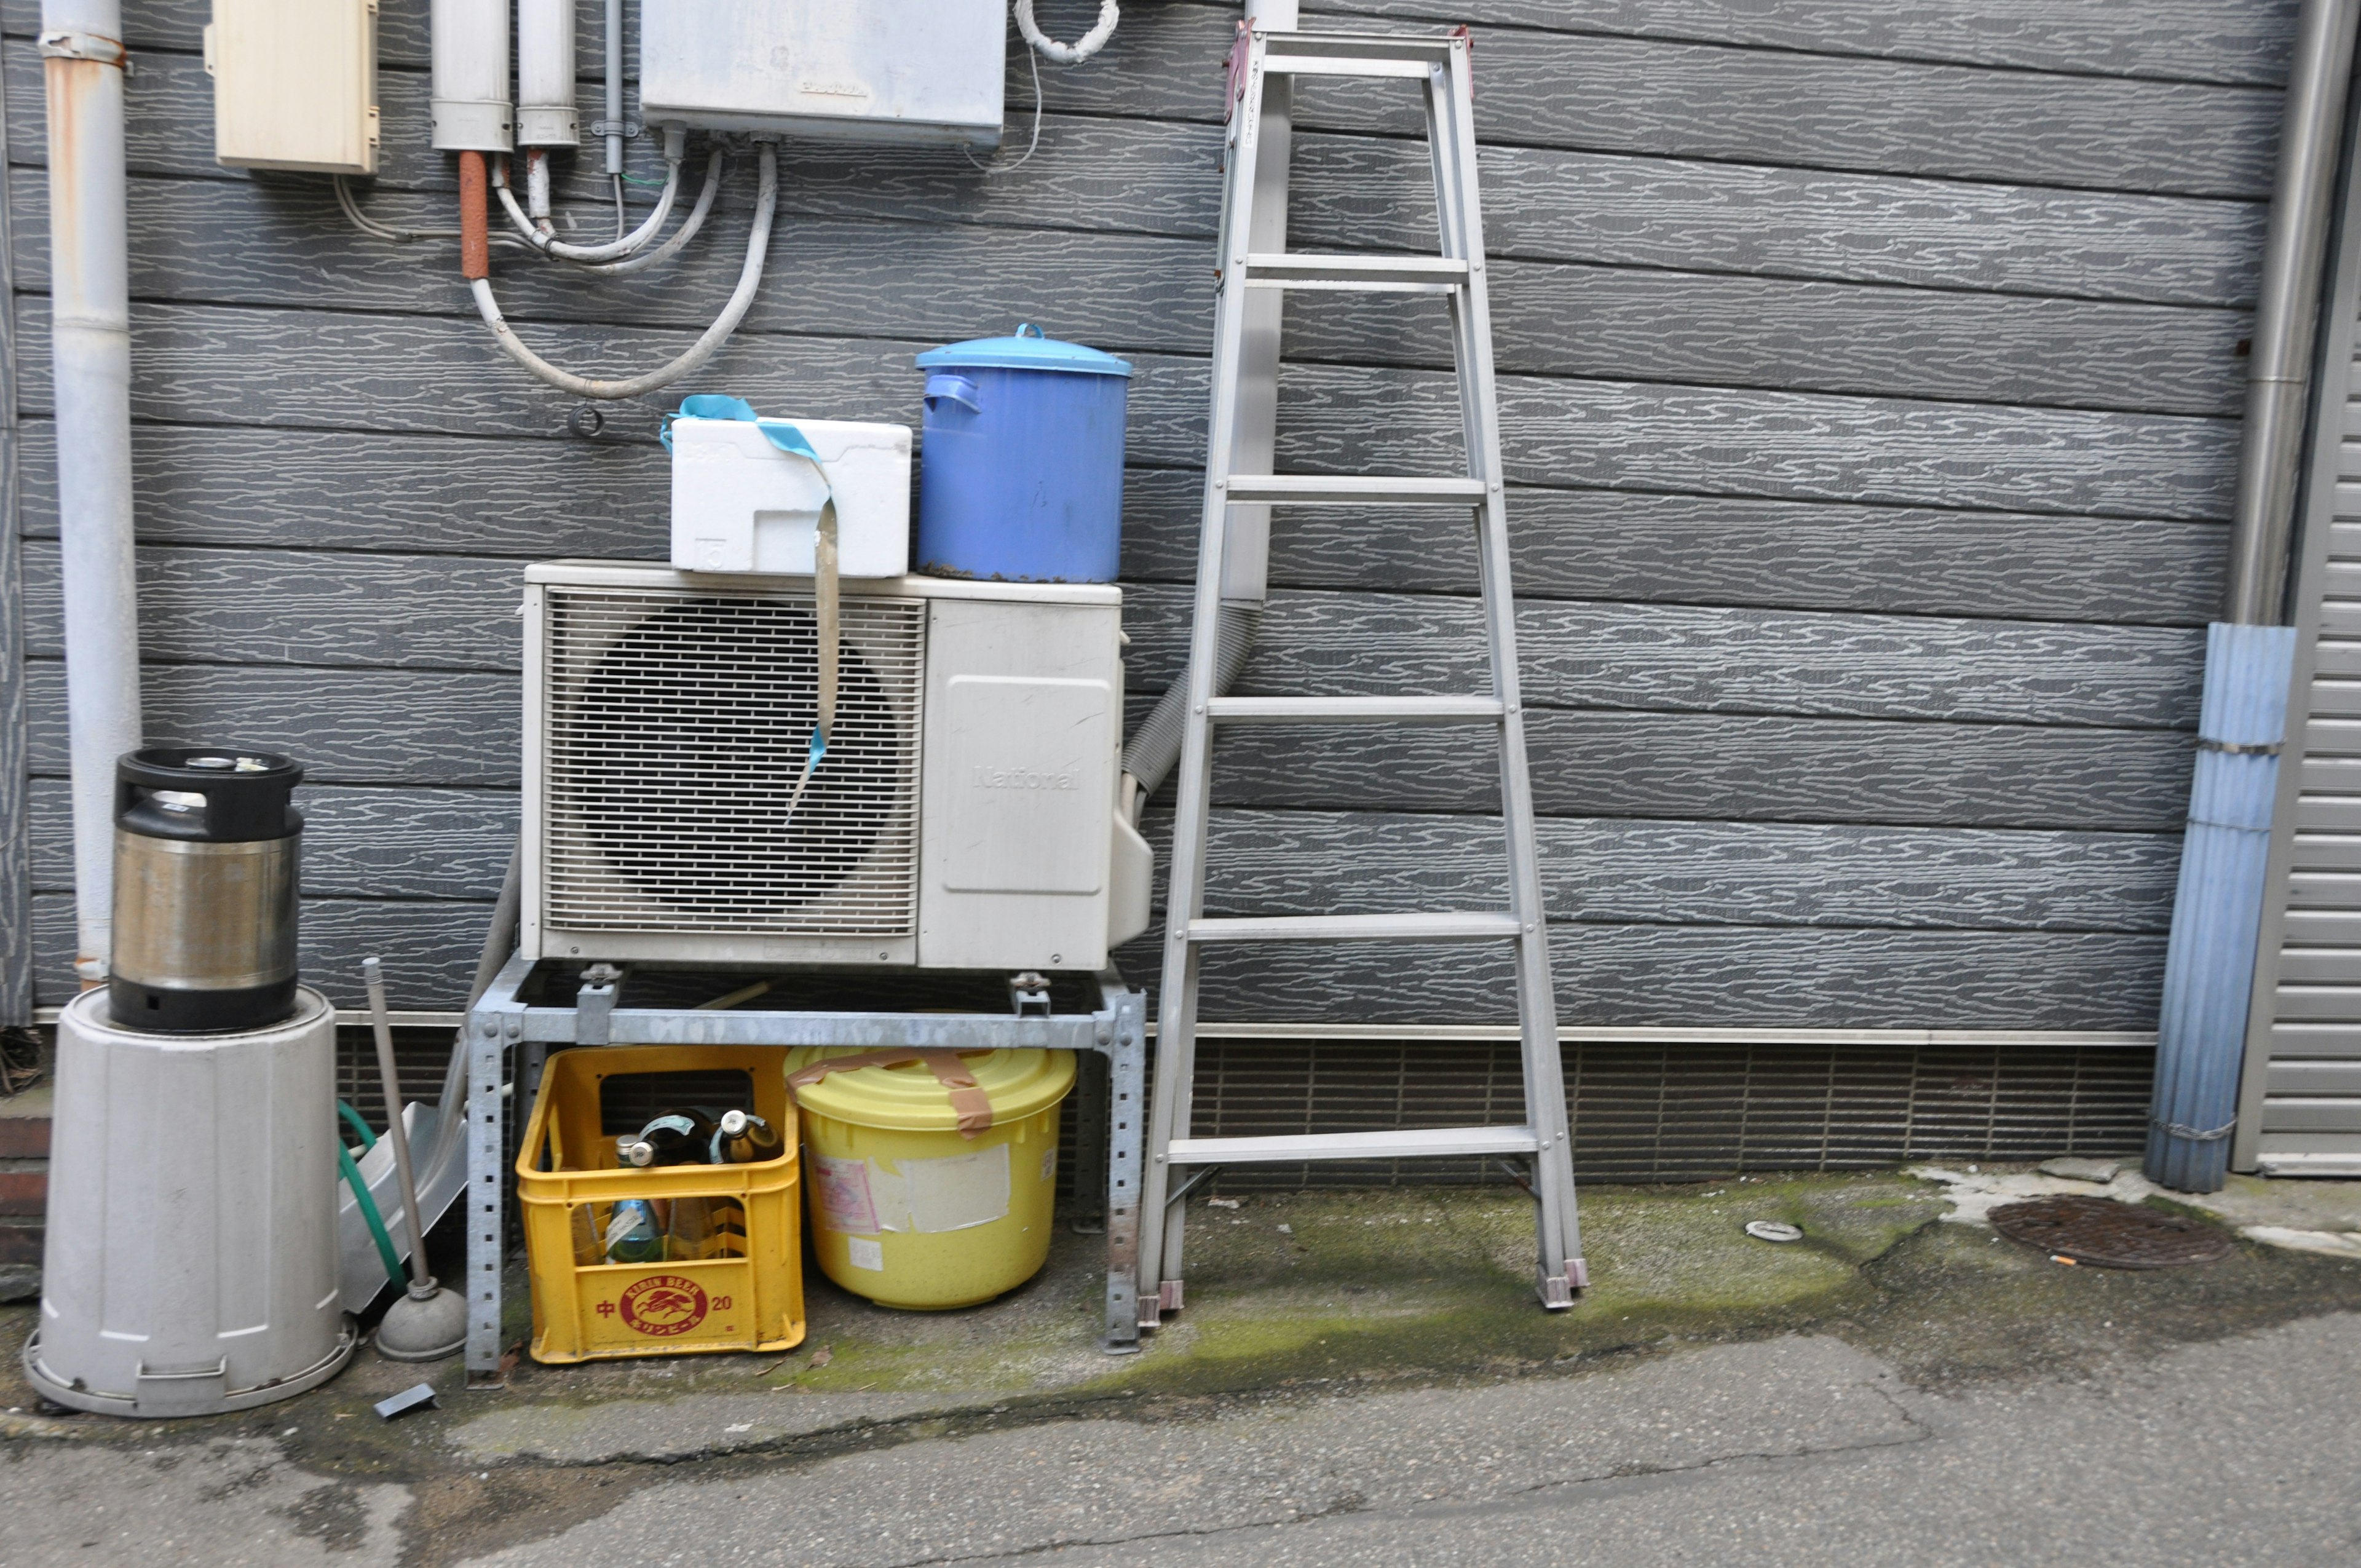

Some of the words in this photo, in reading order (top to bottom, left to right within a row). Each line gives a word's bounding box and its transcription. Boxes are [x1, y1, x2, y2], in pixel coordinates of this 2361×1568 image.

[625, 1278, 662, 1299] KIRIN
[666, 1277, 700, 1296] BEER
[596, 1300, 615, 1318] 中
[712, 1296, 732, 1310] 20
[630, 1315, 701, 1334] キリンビール
